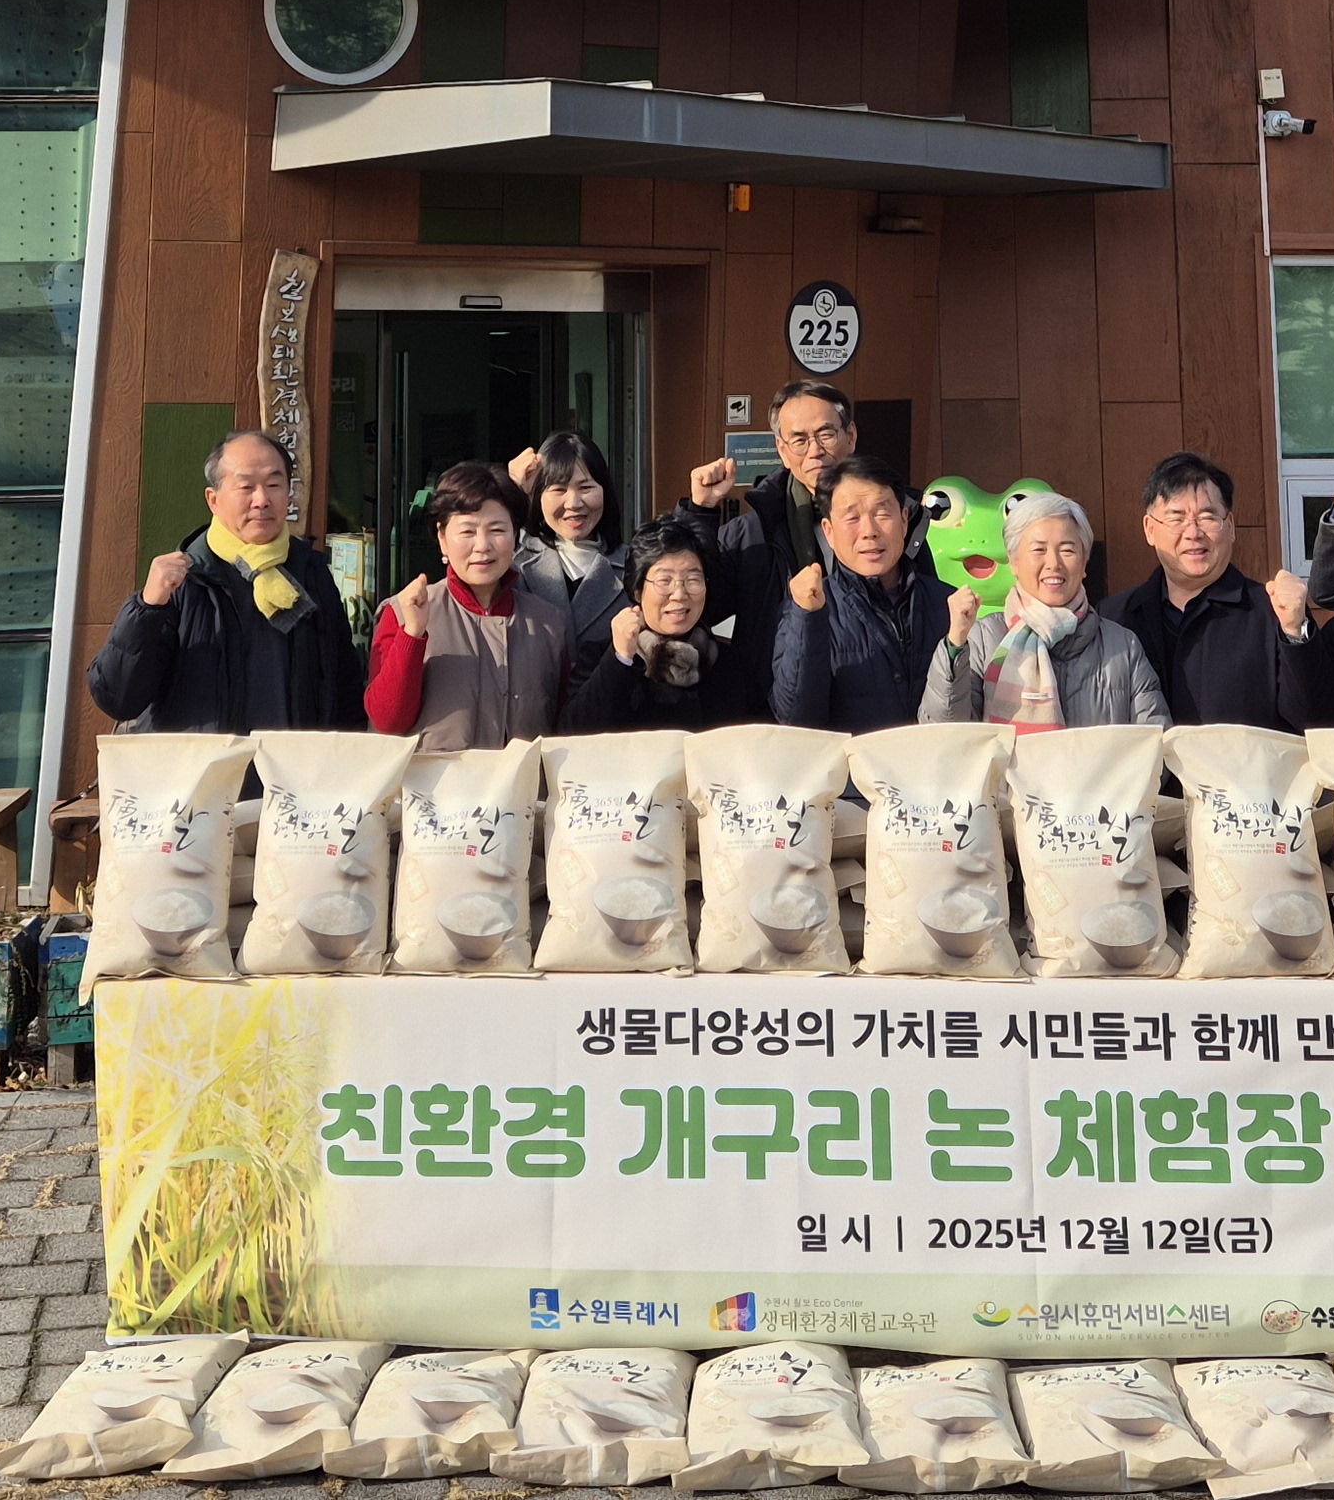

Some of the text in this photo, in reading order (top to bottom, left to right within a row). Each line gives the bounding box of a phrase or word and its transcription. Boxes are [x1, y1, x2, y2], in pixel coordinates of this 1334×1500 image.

[798, 319, 849, 346] 225
[271, 269, 306, 521] 칠보생태환경체험
[576, 1008, 834, 1057] 생물다양성의
[852, 1010, 983, 1059] 가치를
[999, 1011, 1177, 1061] 시민들과
[1191, 1014, 1280, 1063] 함께
[321, 1084, 586, 1180] 친환경
[618, 1086, 892, 1182] 개구리
[925, 1089, 1015, 1182] 논
[1044, 1090, 1332, 1184] 체험장
[928, 1215, 1047, 1253] 2025년
[1059, 1216, 1130, 1255] 12월
[1142, 1216, 1273, 1254] 12일(금)
[567, 1299, 679, 1327] 수원특례시
[764, 1298, 790, 1308] 수원시
[813, 1299, 831, 1308] Eco
[833, 1299, 864, 1308] Center
[1017, 1302, 1231, 1331] 수원시휴먼서비스센터
[760, 1311, 939, 1334] 생태환경체험교육관
[1018, 1332, 1230, 1342] SUWON HUMAN SERVICE CENTER
